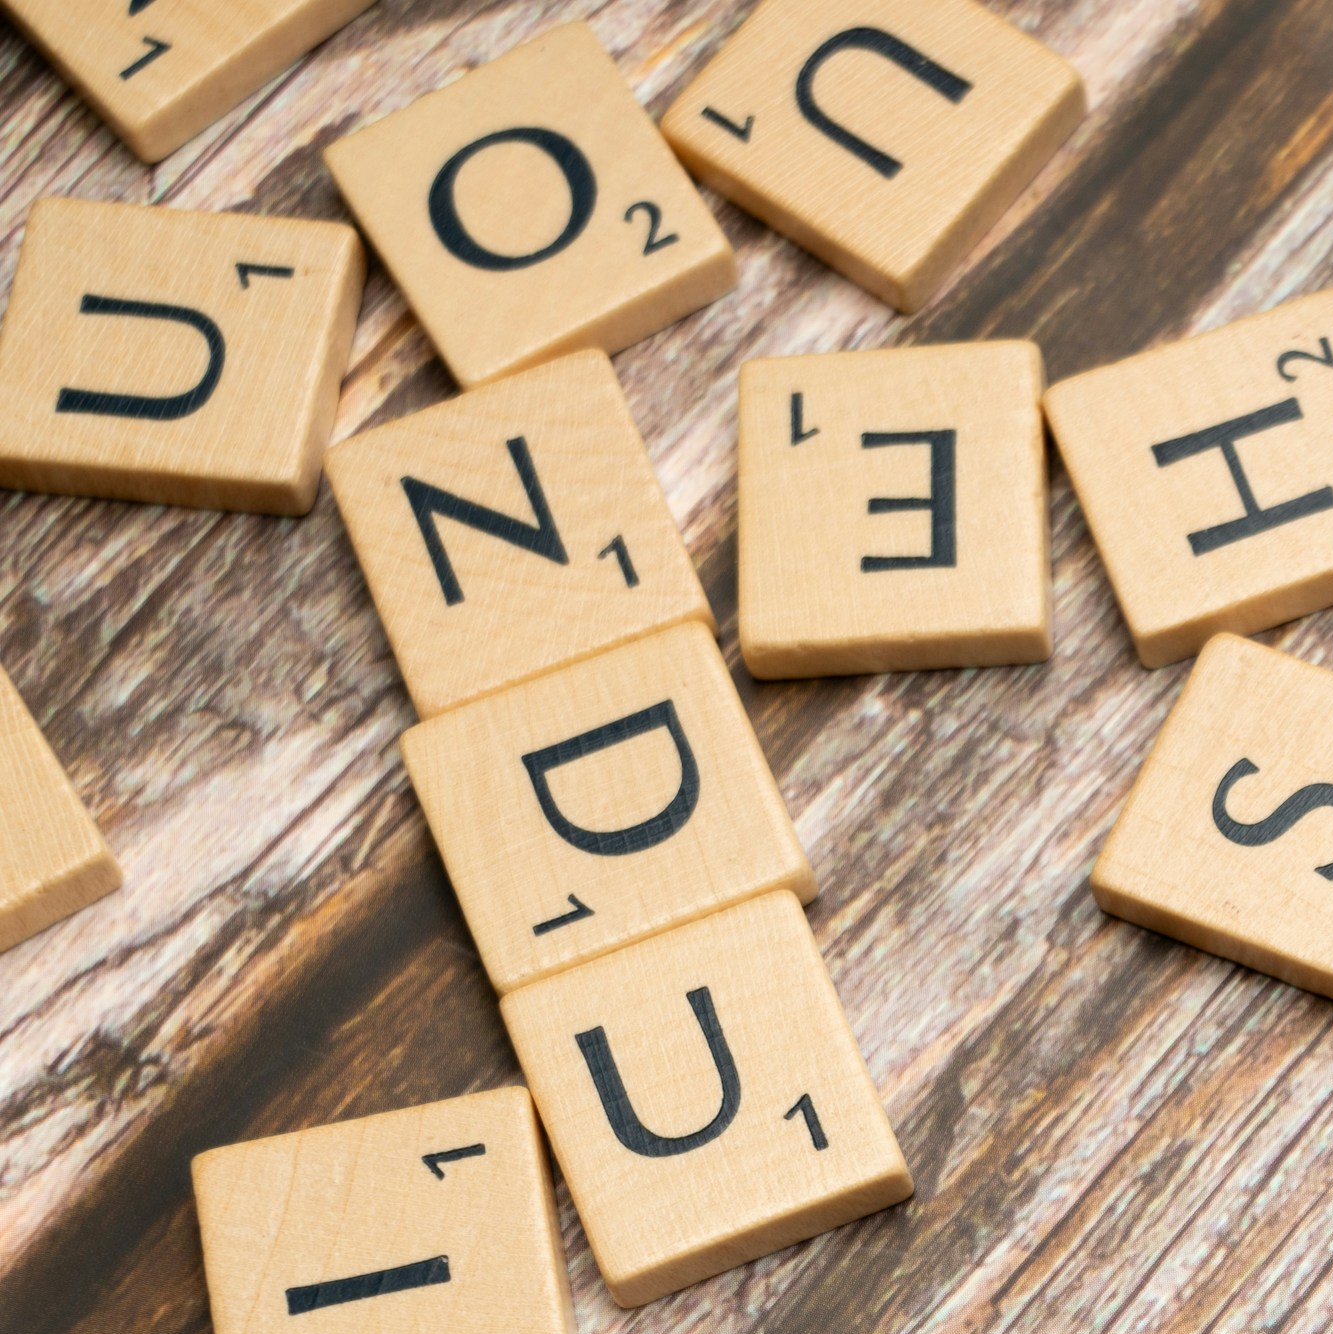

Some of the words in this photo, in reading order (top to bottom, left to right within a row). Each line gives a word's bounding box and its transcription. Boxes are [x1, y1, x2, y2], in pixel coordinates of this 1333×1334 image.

[119, 36, 172, 81] 1
[701, 106, 754, 142] 1
[795, 26, 973, 179] U
[428, 127, 597, 272] O
[624, 201, 679, 256] 2
[55, 294, 225, 421] U
[235, 262, 294, 289] 1
[790, 392, 819, 446] 1
[400, 436, 569, 606] N
[598, 535, 639, 588] 1
[860, 429, 957, 573] E
[521, 699, 700, 856] D
[533, 894, 595, 936] 1
[575, 986, 741, 1158] U
[783, 1093, 829, 1151] 1
[422, 1143, 486, 1180] 1
